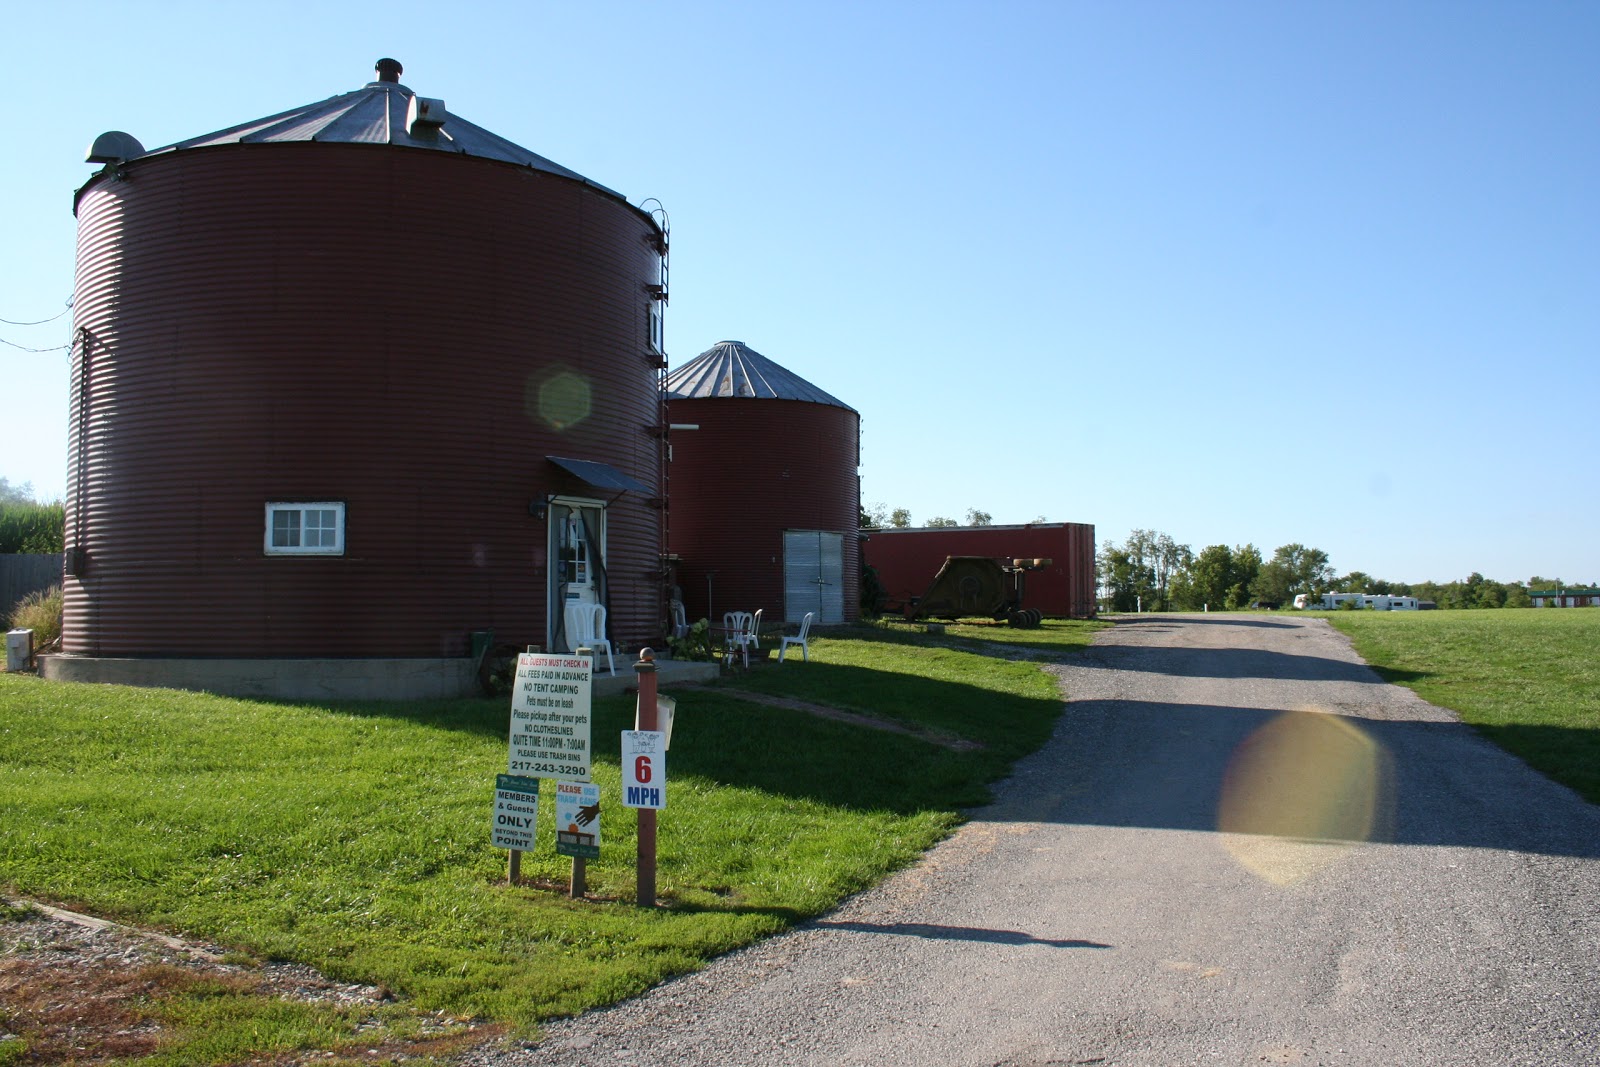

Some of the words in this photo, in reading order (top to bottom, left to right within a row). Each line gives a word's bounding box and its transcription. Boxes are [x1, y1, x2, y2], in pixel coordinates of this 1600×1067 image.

[520, 658, 528, 666] ALL
[530, 658, 548, 666] GUESTS
[548, 659, 562, 667] MUST
[563, 660, 581, 668] CHECK
[582, 660, 589, 668] IN
[518, 670, 527, 678] ALL
[528, 670, 540, 679] FEES
[541, 670, 553, 680] PAID
[555, 672, 561, 680] IN
[562, 672, 589, 681] ADVANCE
[524, 682, 532, 692] NO
[534, 683, 549, 692] TENT
[550, 684, 578, 694] CAMPING
[526, 695, 536, 706] Pets
[537, 697, 547, 707] must
[548, 697, 554, 707] be
[555, 699, 560, 708] on
[561, 698, 574, 709] leash
[513, 709, 529, 720] Please
[530, 710, 548, 723] pickup
[549, 712, 561, 722] after
[562, 714, 574, 724] your
[575, 715, 587, 725] pets
[524, 724, 532, 732] NO
[534, 725, 573, 736] CLOTHESLINES
[513, 734, 527, 746] QUITE
[529, 735, 541, 747] TIME
[542, 736, 563, 749] 11:00PM
[567, 739, 586, 750] 7:00AM
[518, 749, 537, 758] PLEASE
[550, 752, 567, 761] TRASH
[512, 761, 586, 776] 217-243-3290
[635, 756, 651, 783] 6
[558, 784, 581, 794] PLEASE
[584, 788, 596, 796] USE
[628, 786, 660, 806] MPH
[498, 791, 536, 803] MEMBERS
[557, 795, 577, 804] TRASH
[507, 803, 534, 814] Guests
[498, 814, 532, 828] ONLY
[495, 828, 518, 836] BEYOND
[497, 836, 529, 847] POINT
